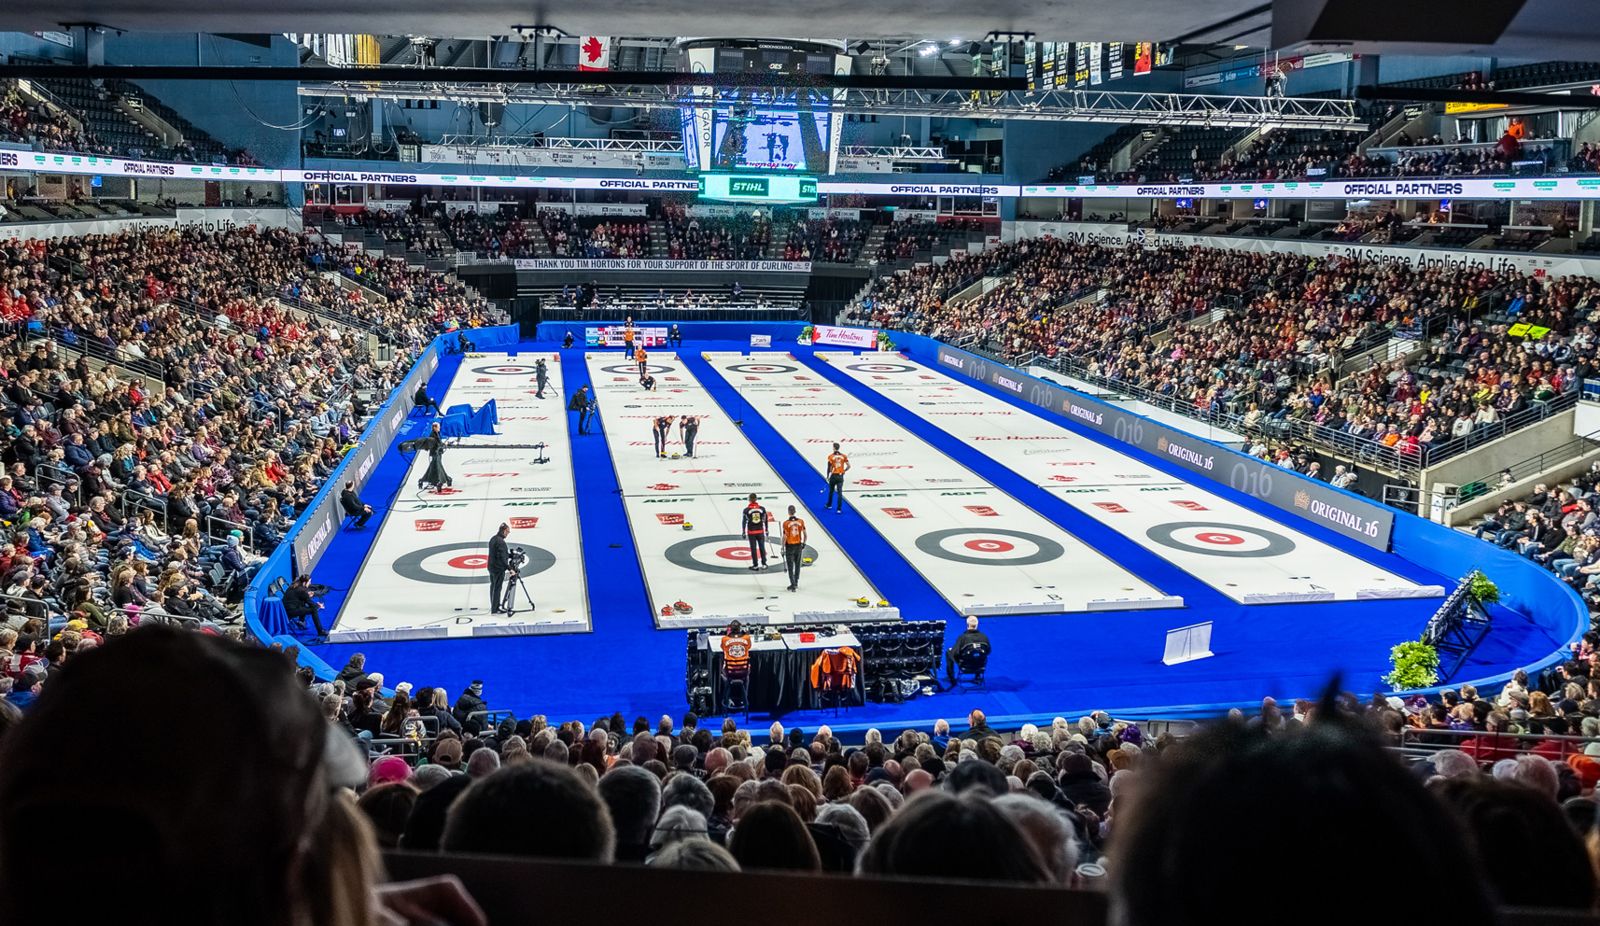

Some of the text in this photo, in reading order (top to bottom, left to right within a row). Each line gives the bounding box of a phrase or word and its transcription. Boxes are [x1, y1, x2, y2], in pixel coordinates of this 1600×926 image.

[124, 162, 174, 175] OFFICIAL PARTNERS
[304, 172, 416, 182] OFFICIAL PARTNERS
[732, 183, 764, 191] STIHL
[1137, 187, 1168, 195] OFFICIAL
[1344, 183, 1462, 195] OFFICIAL PARTNERS
[205, 222, 214, 232] to
[1068, 232, 1084, 244] 3M
[750, 262, 760, 270] OF
[762, 262, 793, 270] CURLING
[1344, 248, 1362, 261] 3M
[1417, 254, 1468, 270] Applied
[1470, 260, 1484, 270] to
[1489, 258, 1516, 274] Life
[1534, 269, 1546, 277] 3M
[826, 329, 864, 341] Tim Hortons
[998, 376, 1017, 391] ORIGINAL
[1070, 404, 1103, 426] ORIGINAL 16
[1114, 416, 1143, 444] O16
[1168, 442, 1213, 471] ORIGINAL 16
[1230, 462, 1273, 498] O16
[1311, 500, 1378, 538] ORIGINAL 16
